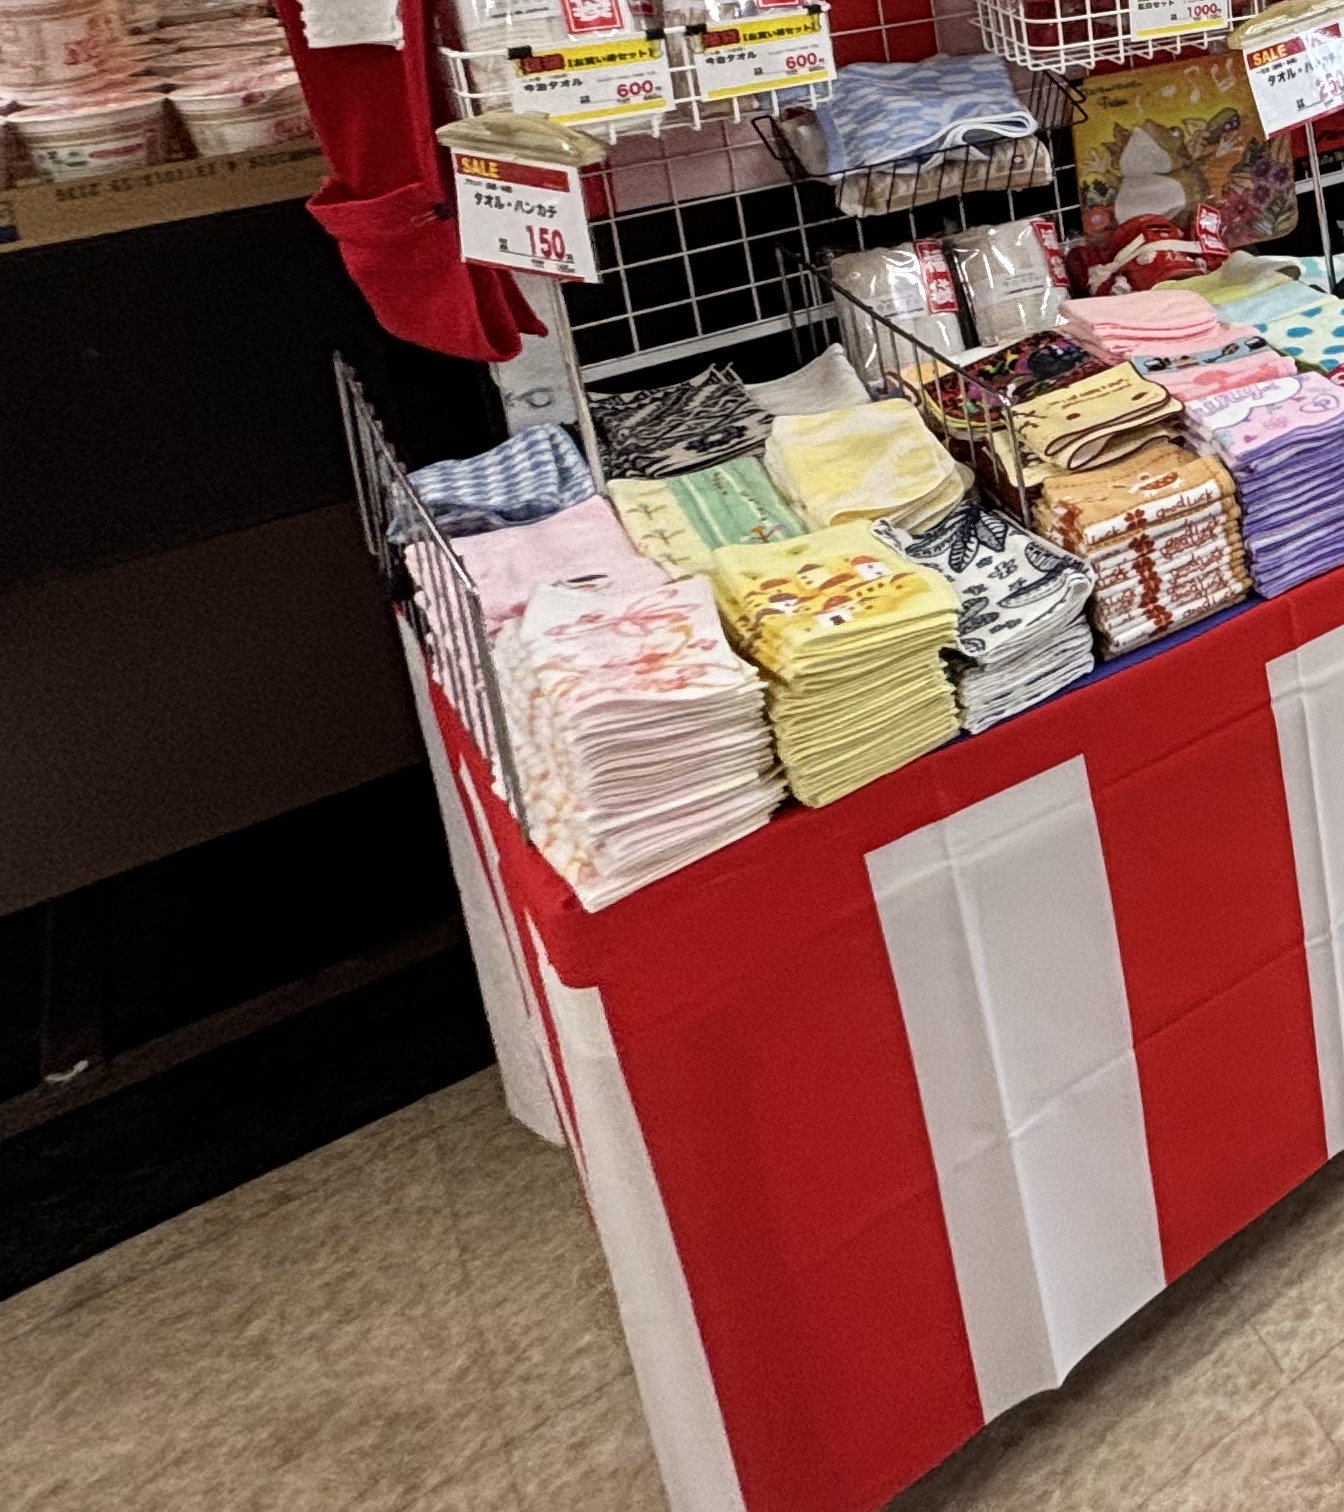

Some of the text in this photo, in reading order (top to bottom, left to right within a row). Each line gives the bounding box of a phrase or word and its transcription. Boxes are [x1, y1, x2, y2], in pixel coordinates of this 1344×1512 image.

[1187, 2, 1218, 18] 1000
[785, 52, 817, 70] 600
[1252, 44, 1288, 66] SALE
[616, 80, 653, 98] 600
[460, 157, 500, 178] SALE
[525, 225, 567, 261] 150
[922, 247, 955, 303] 福袋
